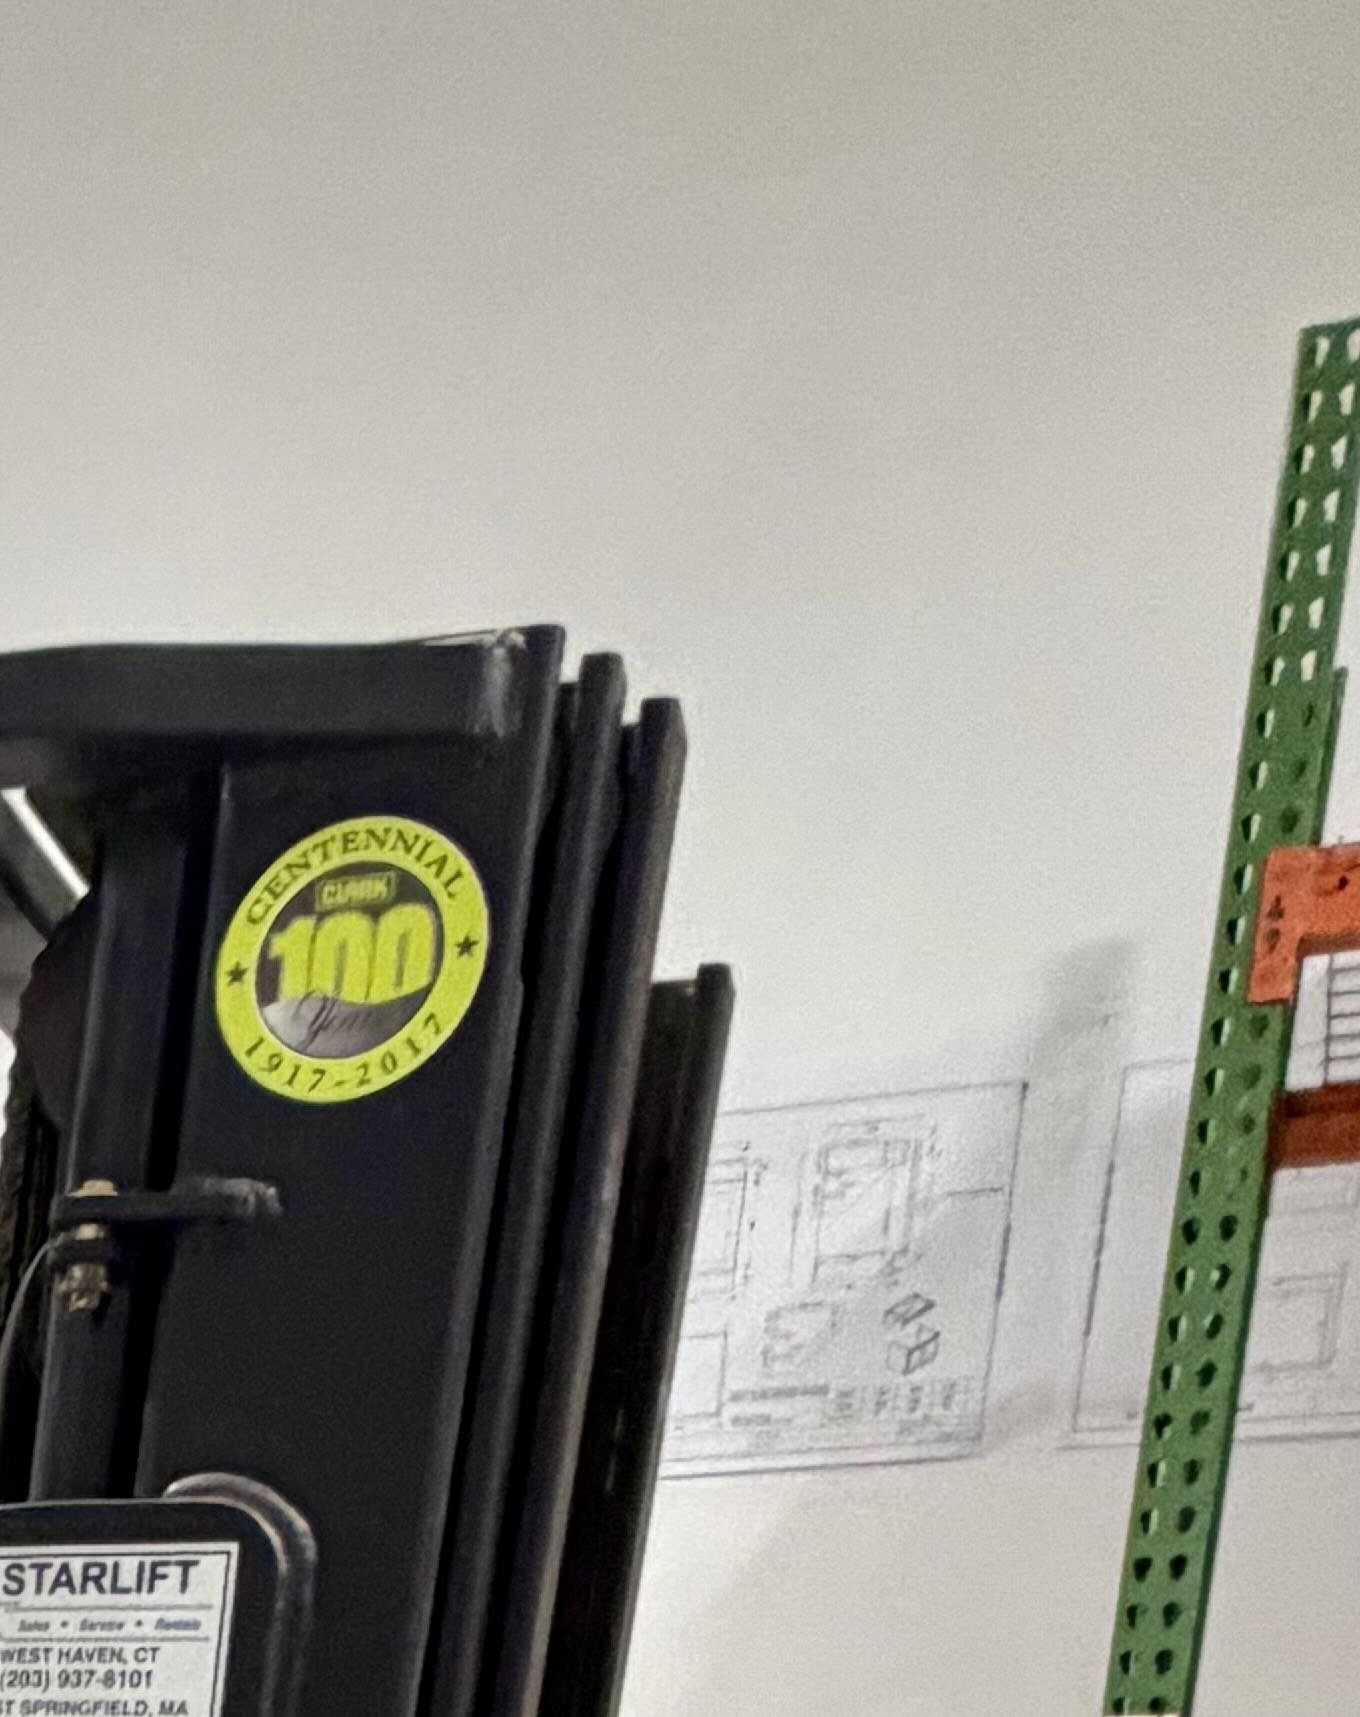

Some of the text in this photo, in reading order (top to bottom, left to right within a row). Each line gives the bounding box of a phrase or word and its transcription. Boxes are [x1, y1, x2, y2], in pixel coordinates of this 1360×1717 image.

[246, 827, 466, 926] CENTENNIAL
[267, 902, 436, 1004] 100
[245, 1012, 443, 1093] 1917-2017
[1, 1559, 200, 1597] STARLIFT
[0, 1647, 160, 1665] WEST HAVEN, CT
[57, 1669, 152, 1689] 937-8101
[159, 1700, 189, 1716] MA
